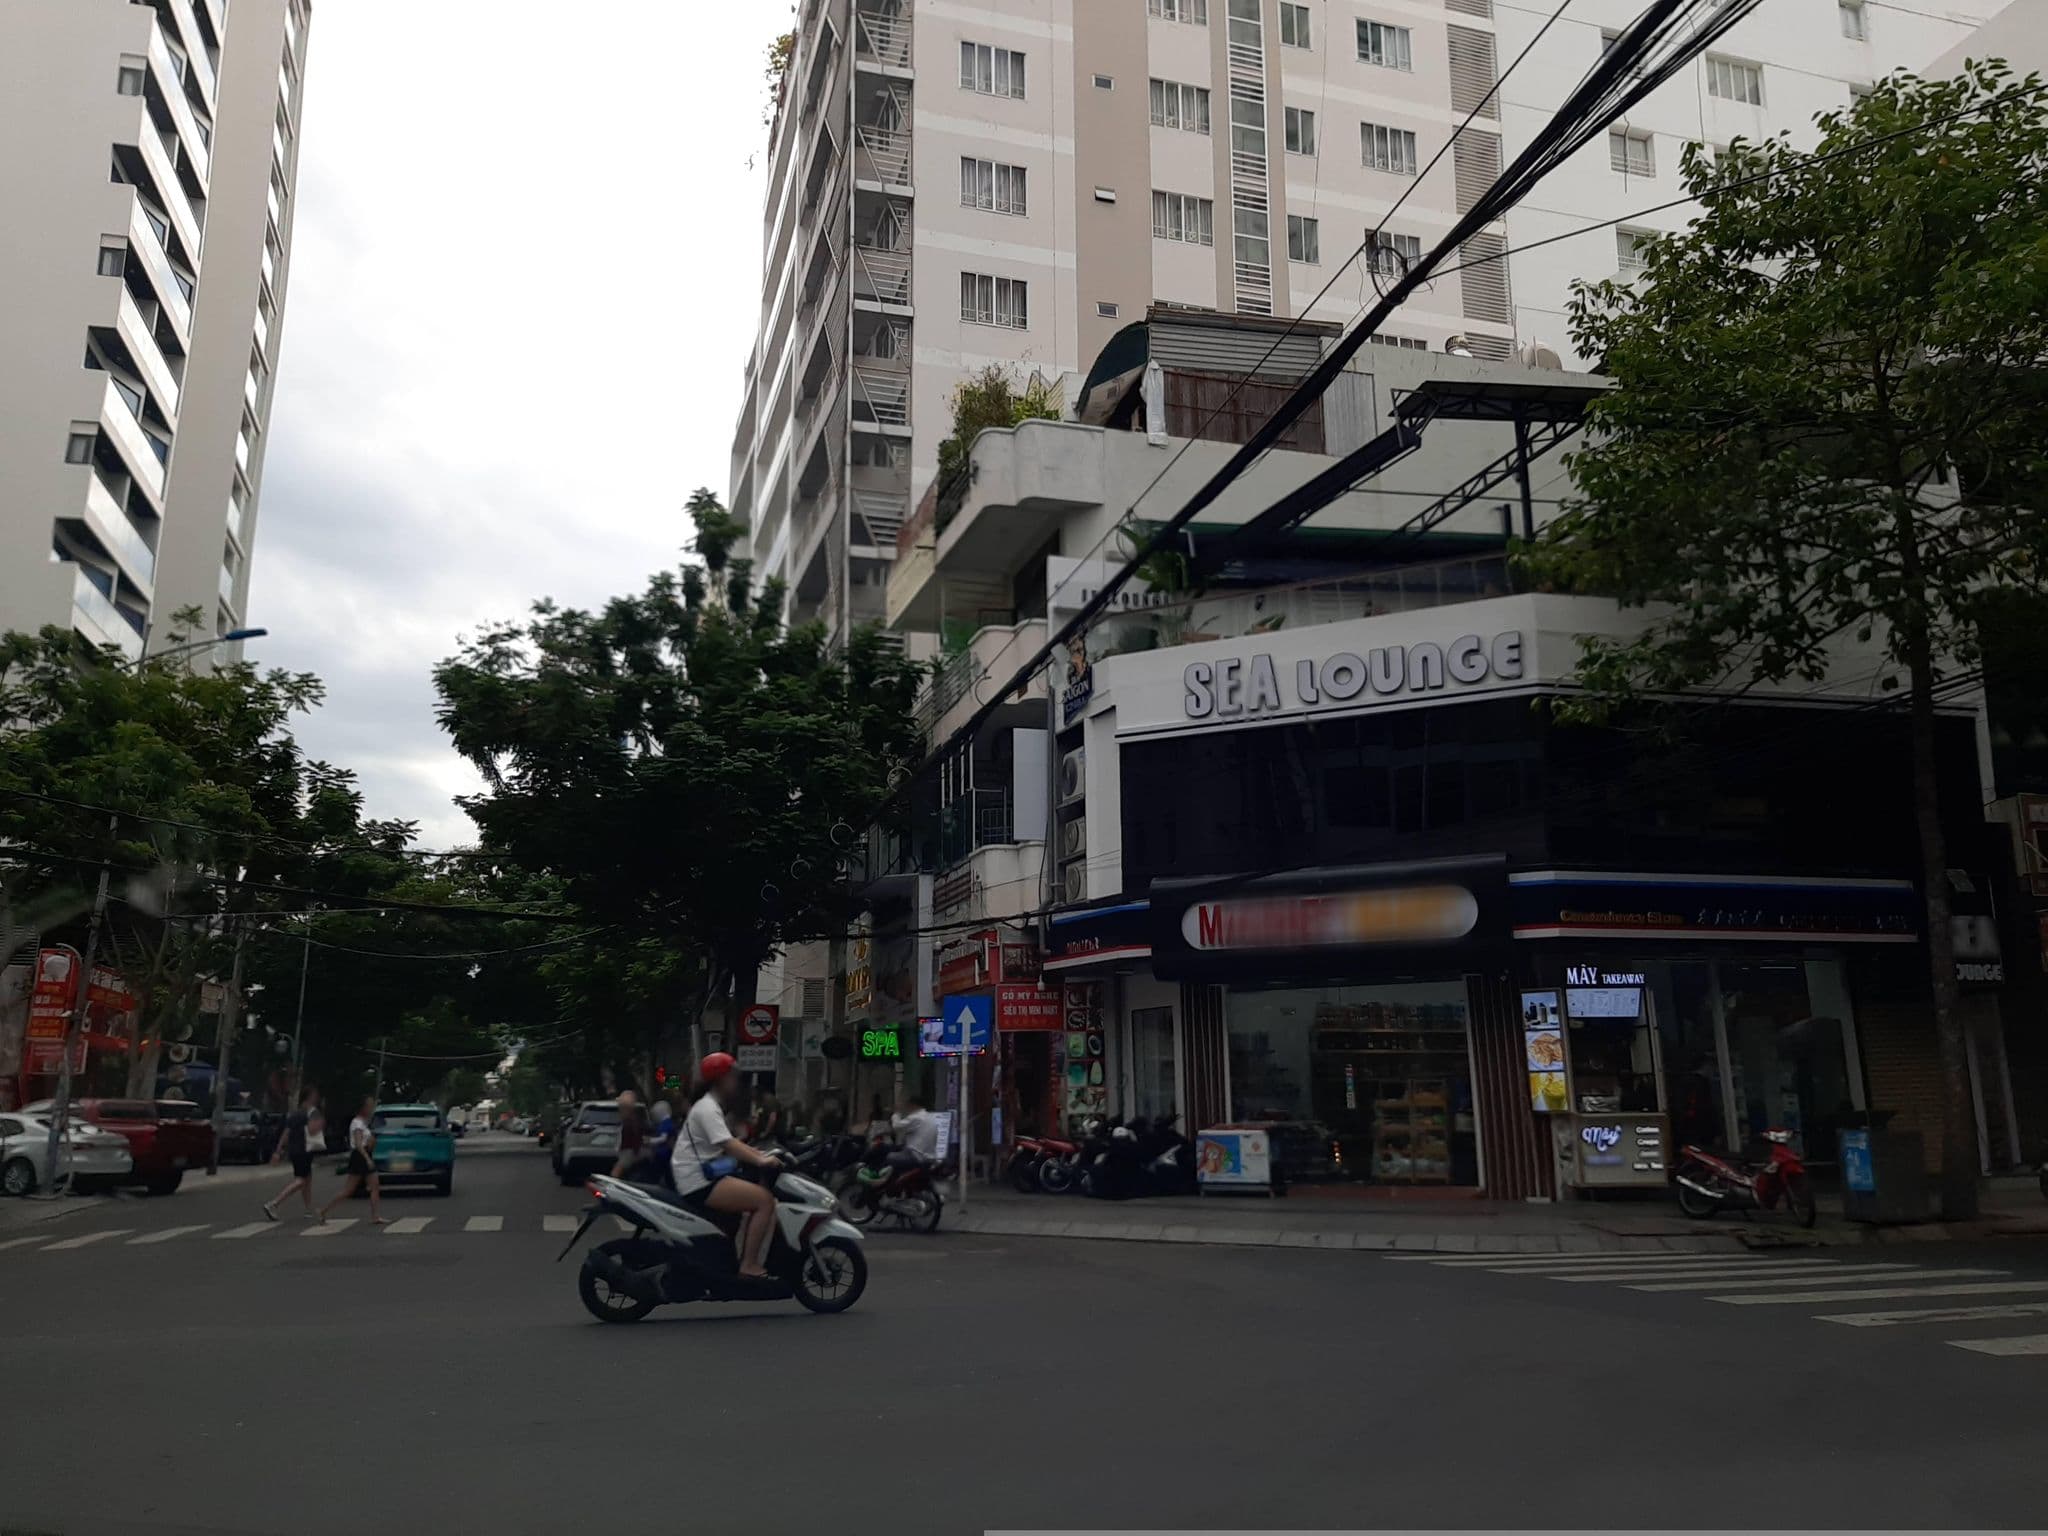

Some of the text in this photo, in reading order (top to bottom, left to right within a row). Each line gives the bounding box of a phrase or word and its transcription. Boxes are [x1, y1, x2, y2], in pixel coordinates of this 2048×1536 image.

[1184, 630, 1523, 718] SEA LOUNGE
[1566, 963, 1645, 985] MÂY TAKEAWAY
[862, 1030, 900, 1057] SPA
